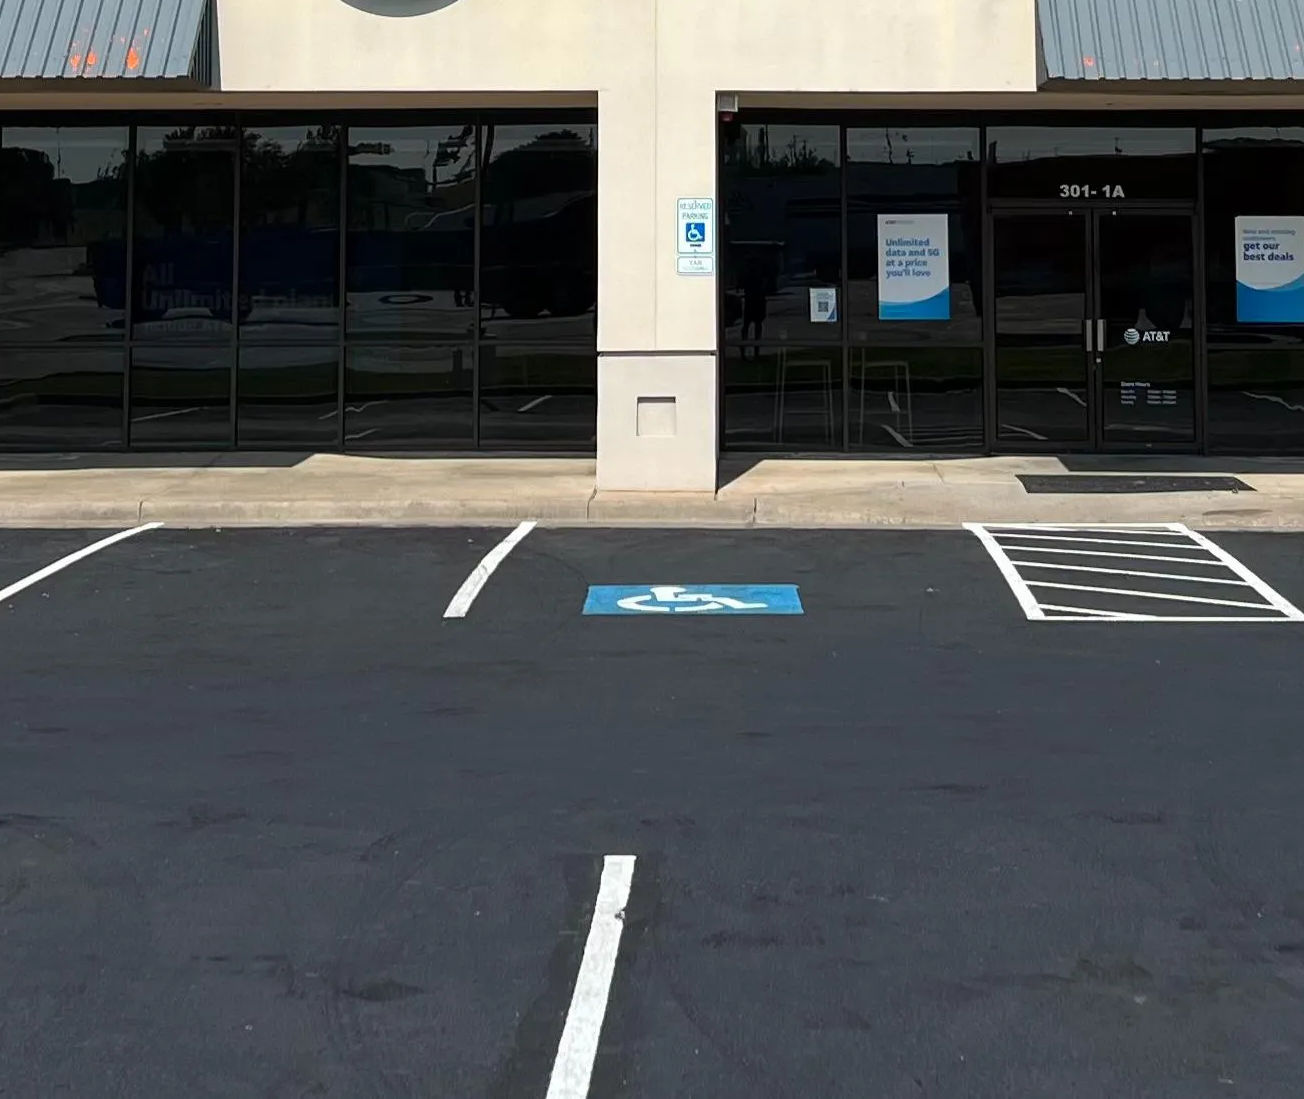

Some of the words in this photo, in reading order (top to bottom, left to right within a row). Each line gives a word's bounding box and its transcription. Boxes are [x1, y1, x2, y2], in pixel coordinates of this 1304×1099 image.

[1059, 184, 1097, 198] 301-
[1101, 184, 1126, 198] 1A
[885, 237, 930, 247] Unlimited
[1243, 242, 1261, 252] get
[1262, 242, 1281, 250] our
[885, 247, 907, 257] data
[908, 248, 926, 257] and
[927, 248, 940, 257] 5G
[1243, 251, 1266, 261] best
[1267, 251, 1295, 261] deals
[885, 259, 896, 267] at
[904, 257, 928, 269] price
[911, 268, 932, 277] love
[1142, 330, 1171, 342] AT&T
